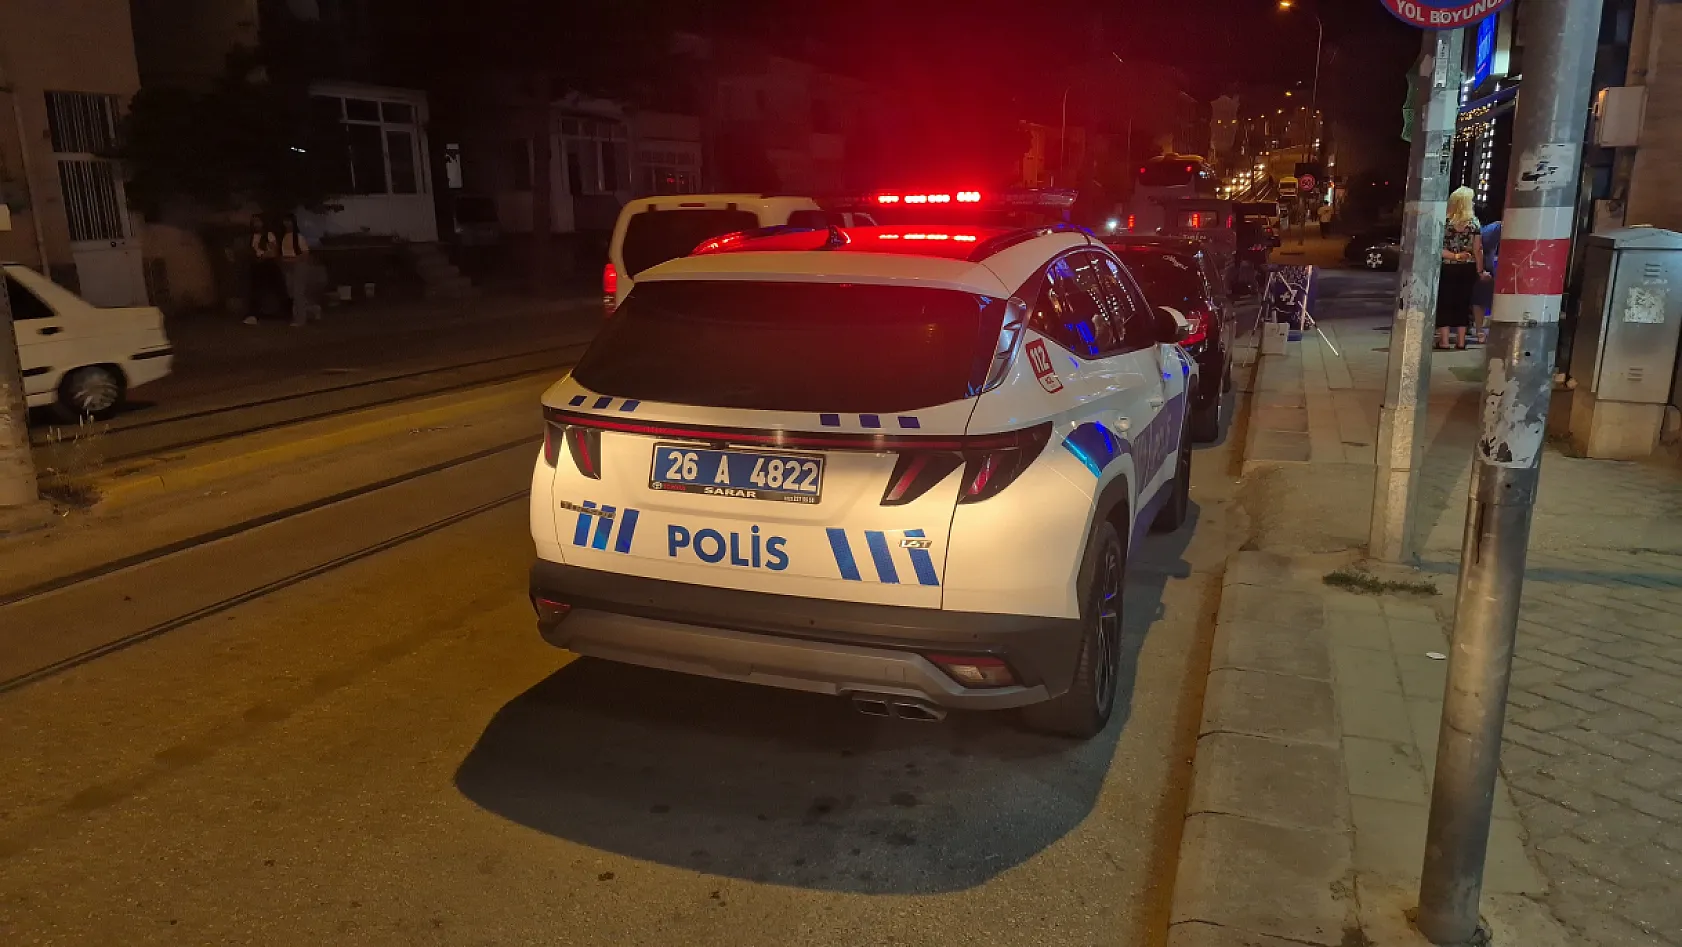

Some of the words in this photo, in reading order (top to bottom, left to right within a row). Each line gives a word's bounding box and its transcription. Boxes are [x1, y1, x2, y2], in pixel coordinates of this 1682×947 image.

[1396, 0, 1425, 21] YOL
[1430, 0, 1501, 24] BOYUND
[1030, 345, 1050, 373] 112
[666, 451, 698, 480] 26
[714, 455, 730, 484] A
[750, 457, 818, 492] 4822
[704, 487, 756, 498] SARAR
[667, 524, 789, 571] POLİS
